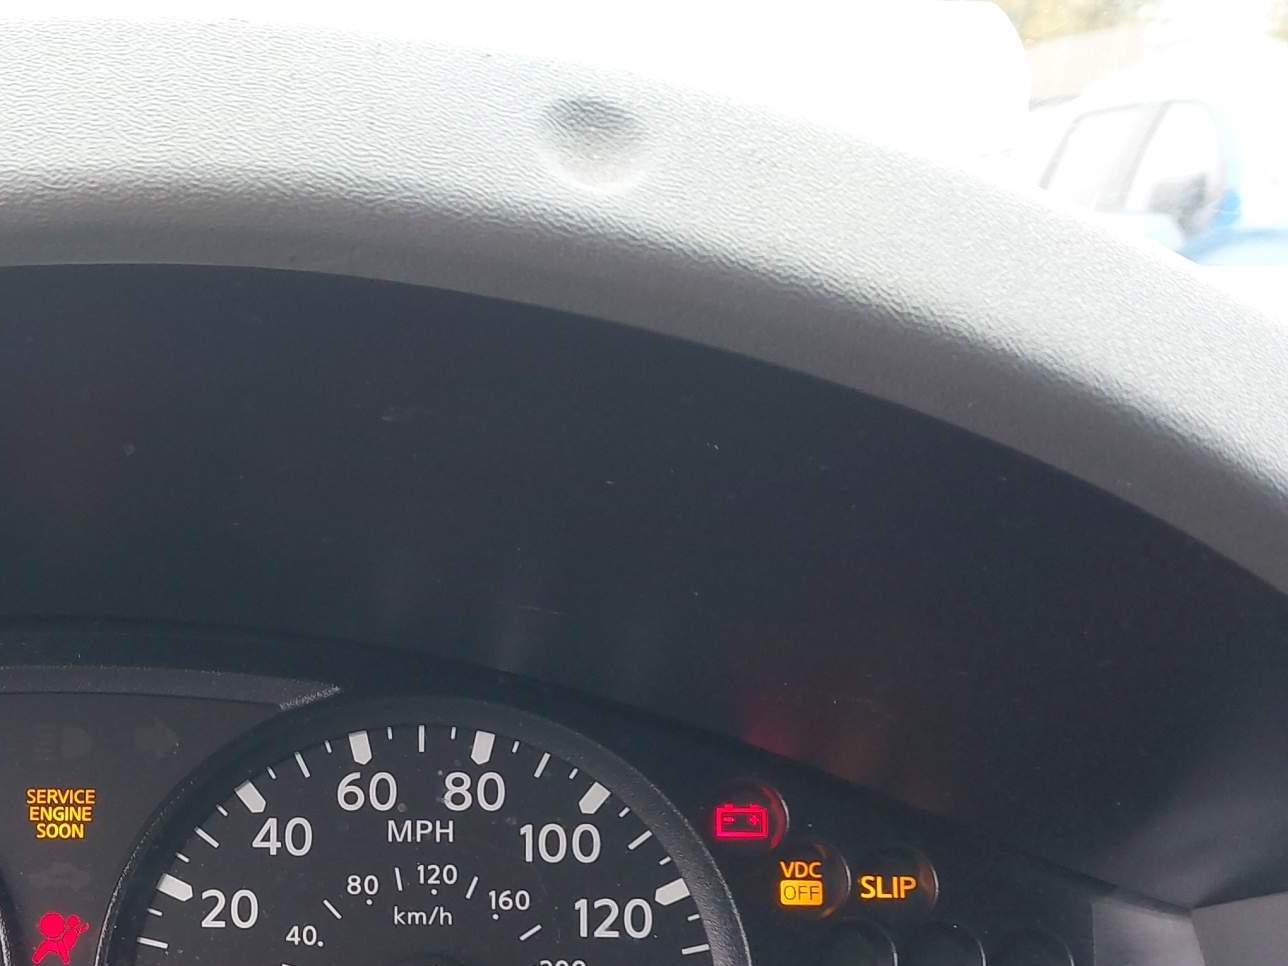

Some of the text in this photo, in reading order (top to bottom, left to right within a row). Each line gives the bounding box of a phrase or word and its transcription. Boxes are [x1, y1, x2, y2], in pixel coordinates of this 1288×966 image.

[27, 789, 94, 804] SERVICE
[338, 772, 396, 810] 60
[444, 772, 505, 811] 80
[30, 807, 91, 821] ENGINE
[37, 823, 83, 838] SOON
[253, 818, 312, 856] 40
[388, 820, 453, 842] MPH
[520, 824, 600, 863] 100
[418, 865, 457, 884] 120
[781, 862, 821, 878] VDC
[348, 876, 378, 894] 80
[783, 884, 820, 901] OFF
[861, 876, 916, 898] SLIP
[202, 890, 258, 928] 20
[489, 891, 529, 910] 160
[395, 907, 452, 924] km/h
[575, 899, 652, 938] 120
[286, 926, 316, 945] 40
